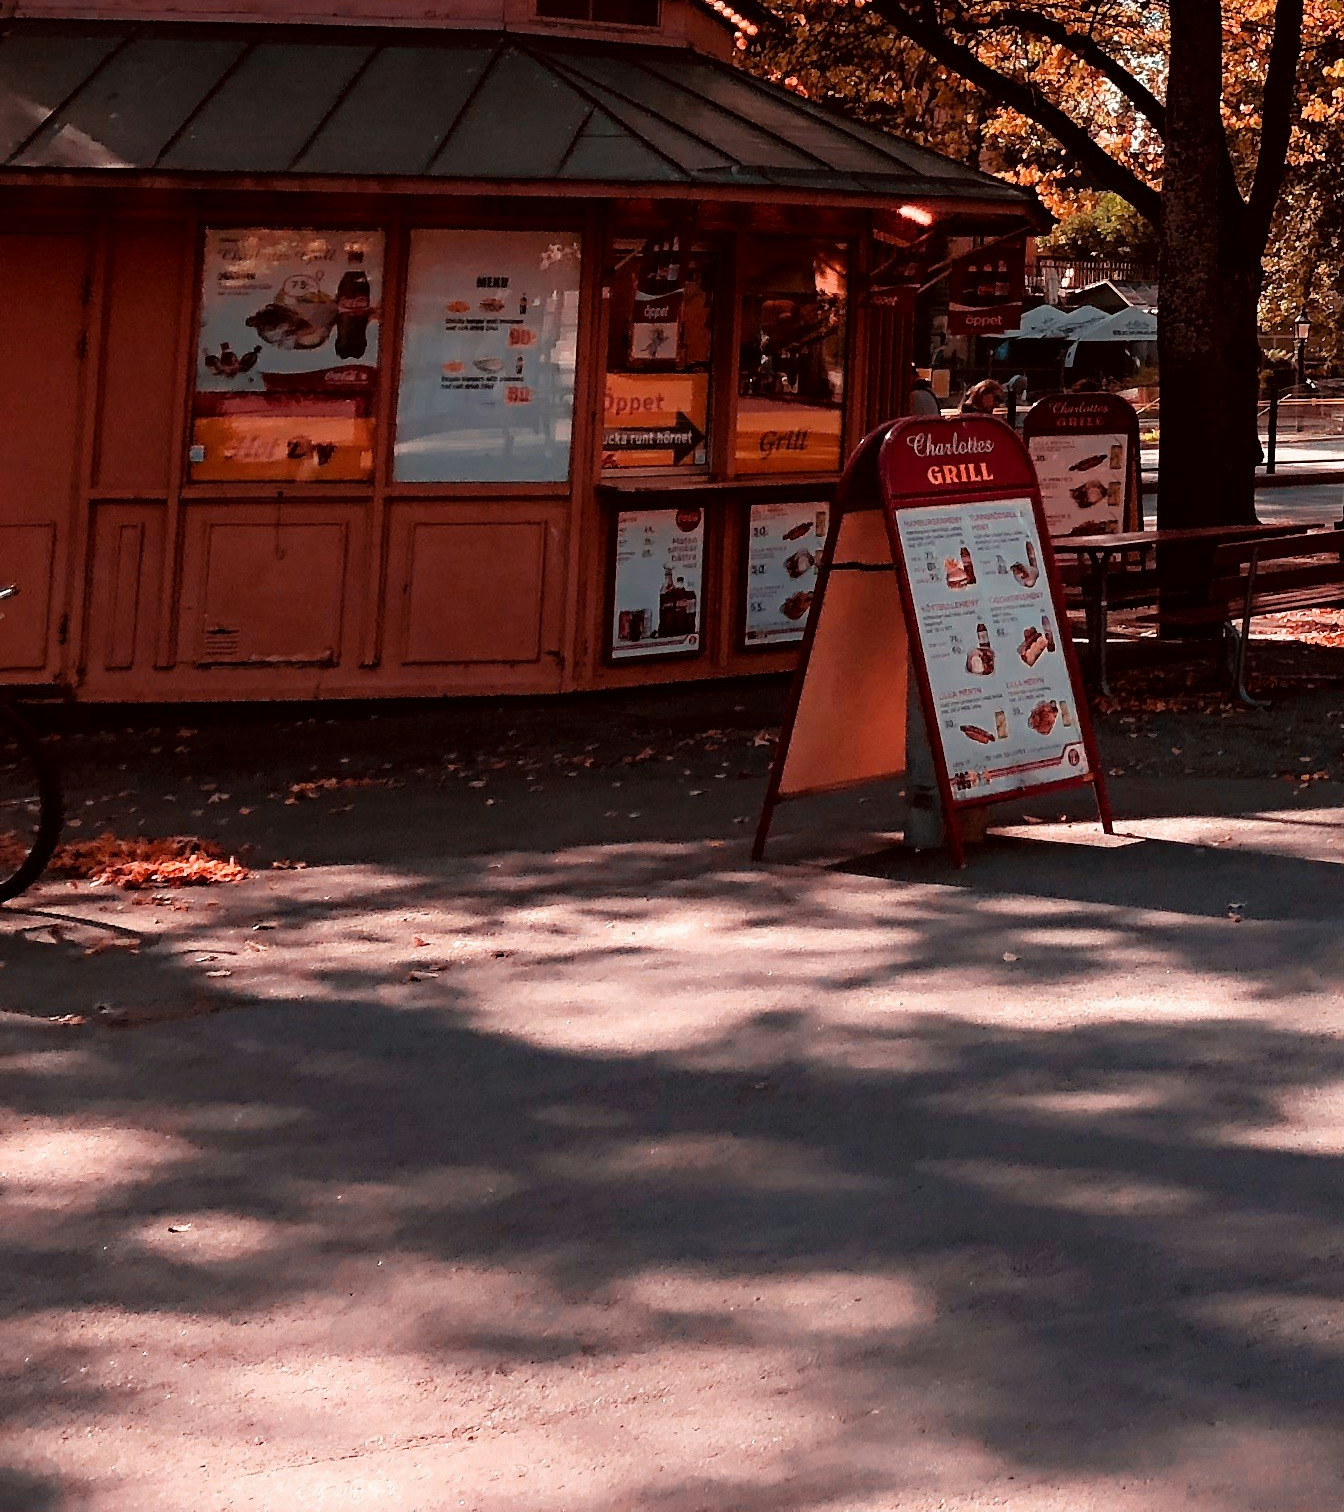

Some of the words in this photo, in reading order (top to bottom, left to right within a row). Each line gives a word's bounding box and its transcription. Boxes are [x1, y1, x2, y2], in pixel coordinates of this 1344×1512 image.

[476, 276, 509, 289] MENU
[644, 304, 669, 319] öppet
[965, 314, 1003, 327] öppet
[1049, 401, 1109, 414] Charlottes
[630, 431, 654, 445] runt
[656, 430, 693, 445] hörnet
[759, 429, 808, 459] Grill
[906, 432, 995, 457] Charlottes
[927, 462, 994, 485] GRILL
